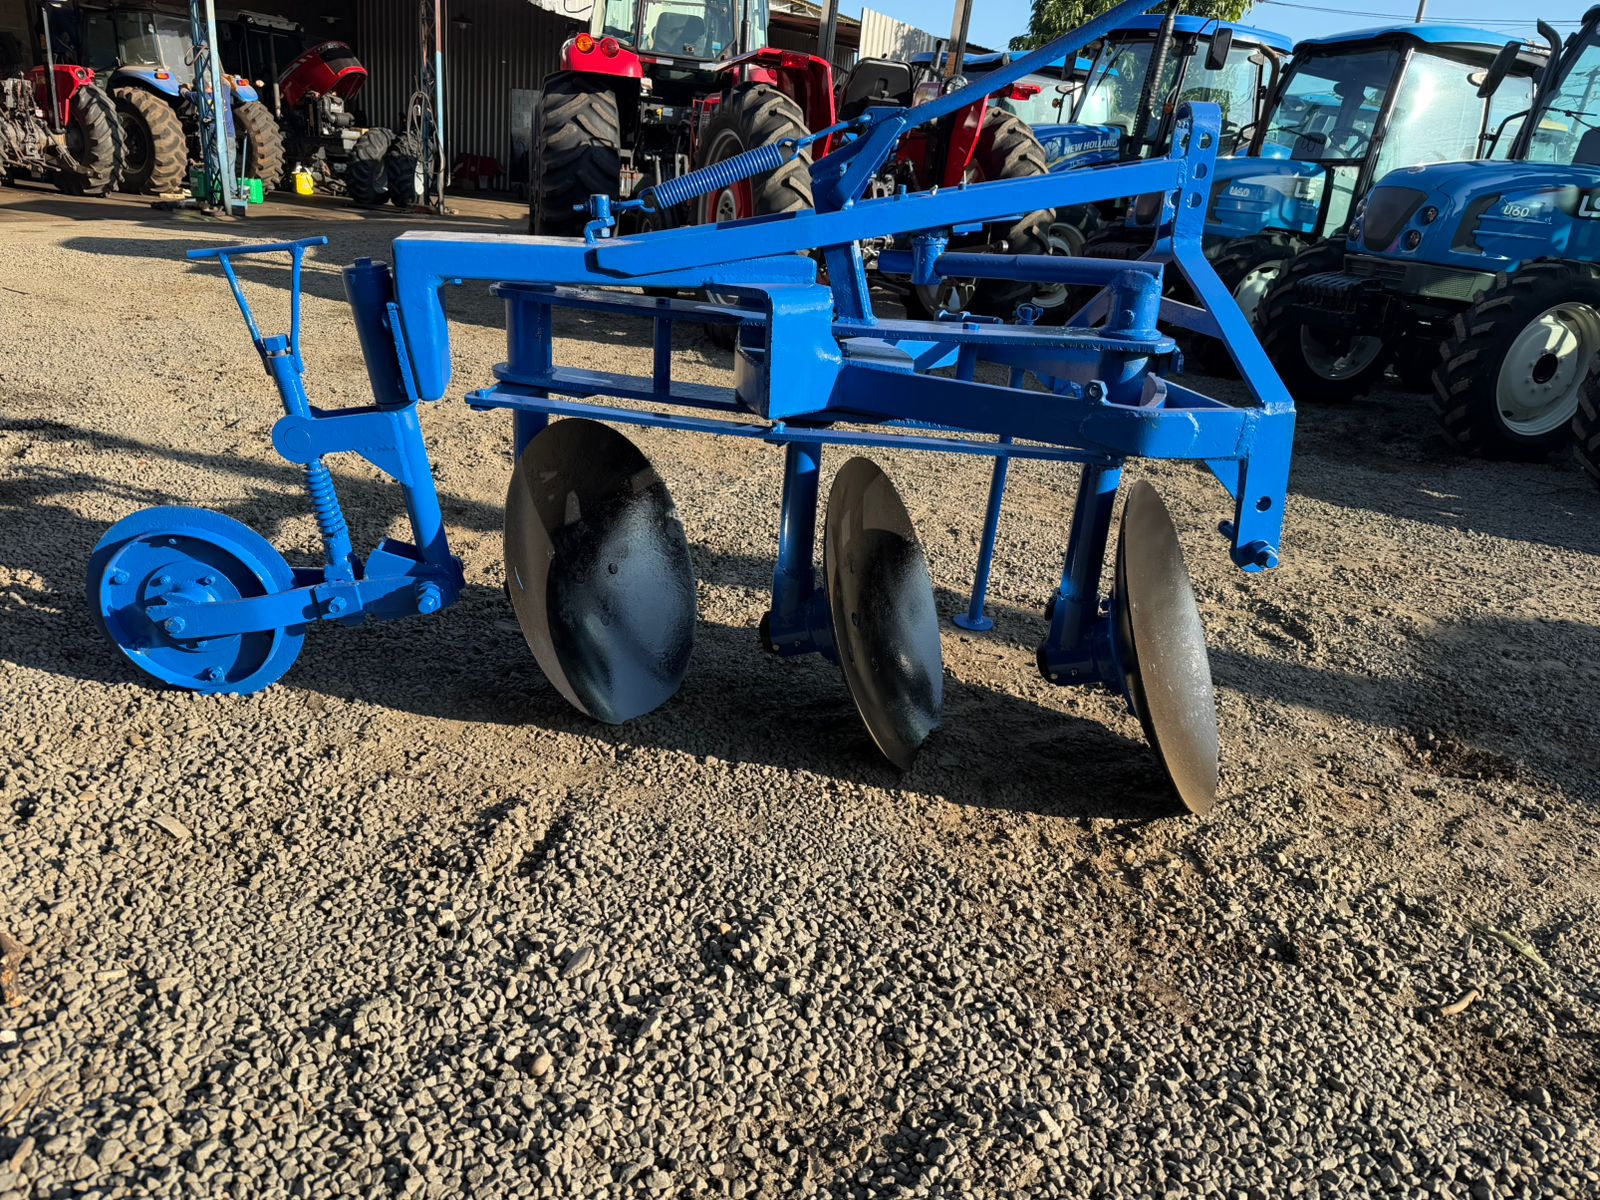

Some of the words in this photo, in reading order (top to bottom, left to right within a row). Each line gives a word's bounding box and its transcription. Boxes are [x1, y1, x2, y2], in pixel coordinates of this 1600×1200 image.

[1064, 143, 1083, 155] NEW
[1083, 139, 1118, 150] HOLLAND
[1295, 181, 1316, 199] LS
[1503, 204, 1530, 218] U60
